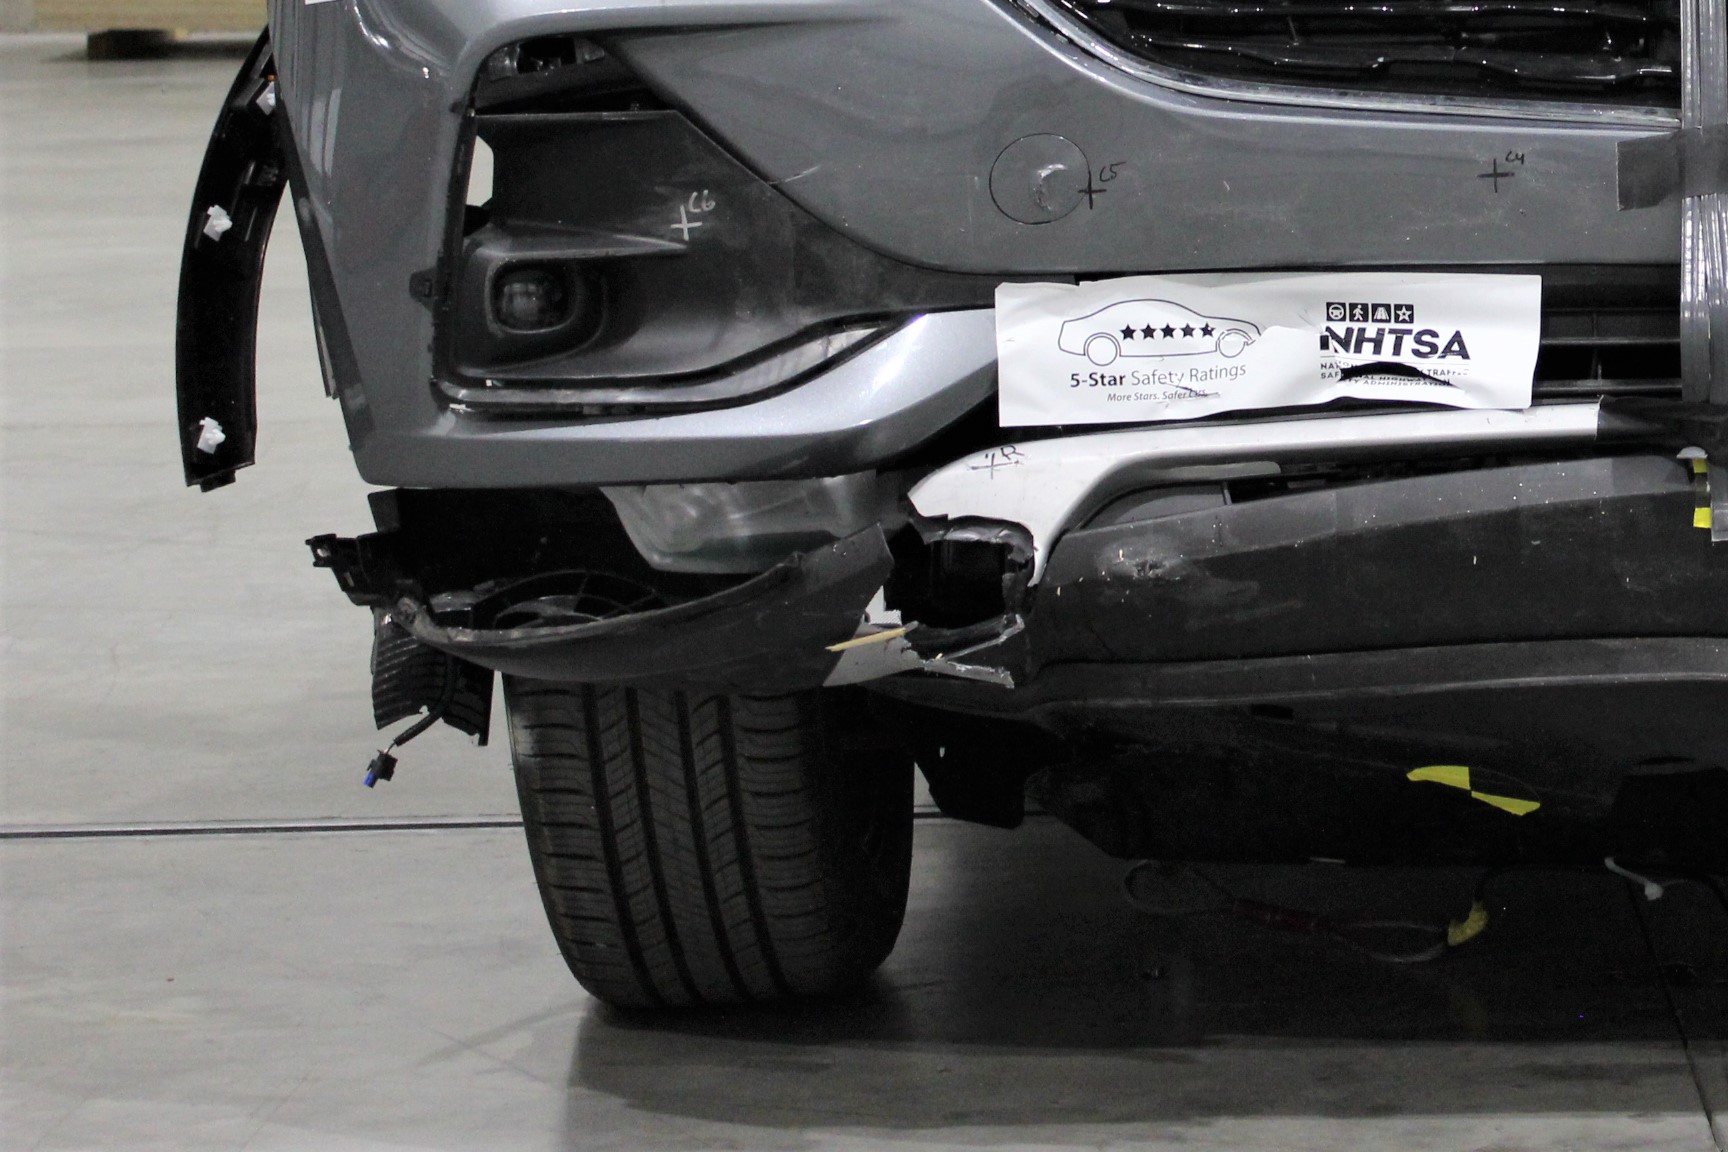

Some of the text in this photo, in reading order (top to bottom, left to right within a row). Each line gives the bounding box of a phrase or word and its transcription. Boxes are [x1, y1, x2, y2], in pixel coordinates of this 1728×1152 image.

[1320, 325, 1471, 360] NHTSA
[1070, 363, 1247, 388] 5-Star Safety Ratings
[1106, 392, 1132, 402] More
[1133, 391, 1160, 401] Stars.
[1161, 390, 1187, 400] Safer
